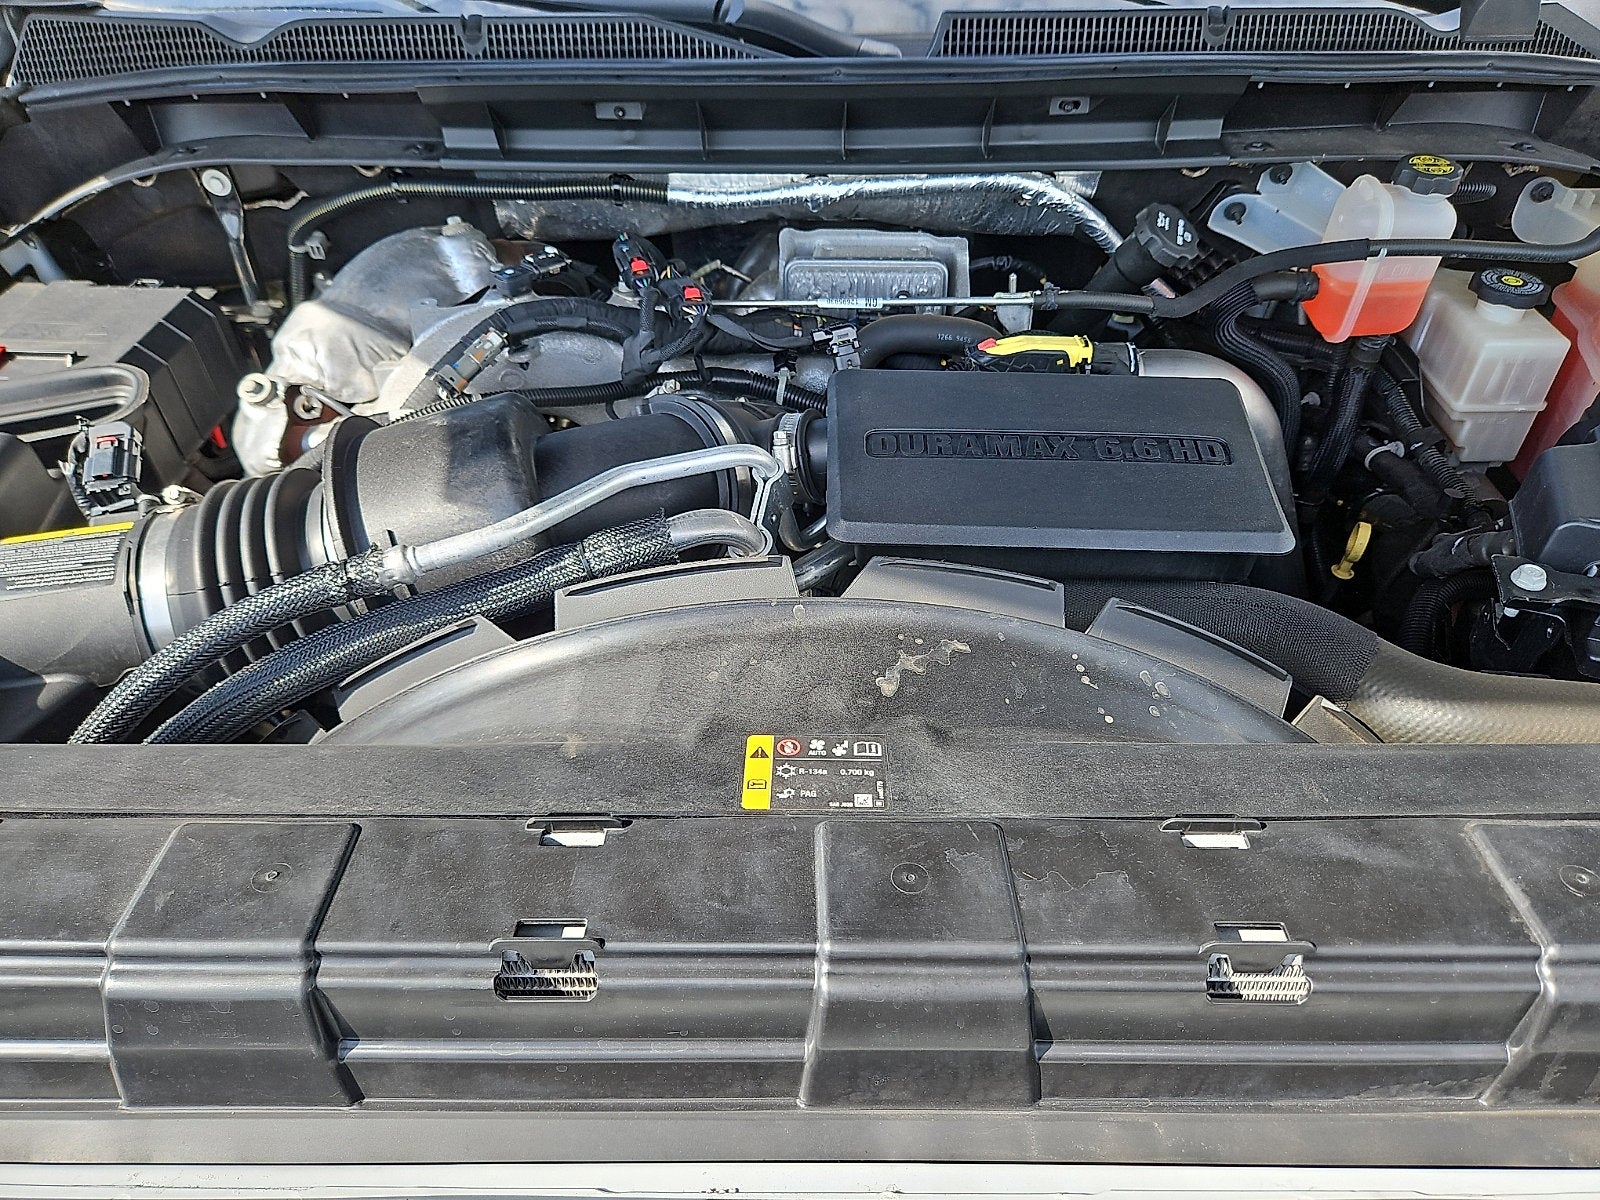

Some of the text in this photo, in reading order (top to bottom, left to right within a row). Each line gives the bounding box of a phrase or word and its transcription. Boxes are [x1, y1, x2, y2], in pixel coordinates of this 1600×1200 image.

[865, 298, 878, 307] GM
[870, 433, 1226, 463] DURAMAX 6.6 HD
[840, 768, 862, 776] 0.700
[864, 769, 875, 777] kg
[800, 789, 817, 798] PAG
